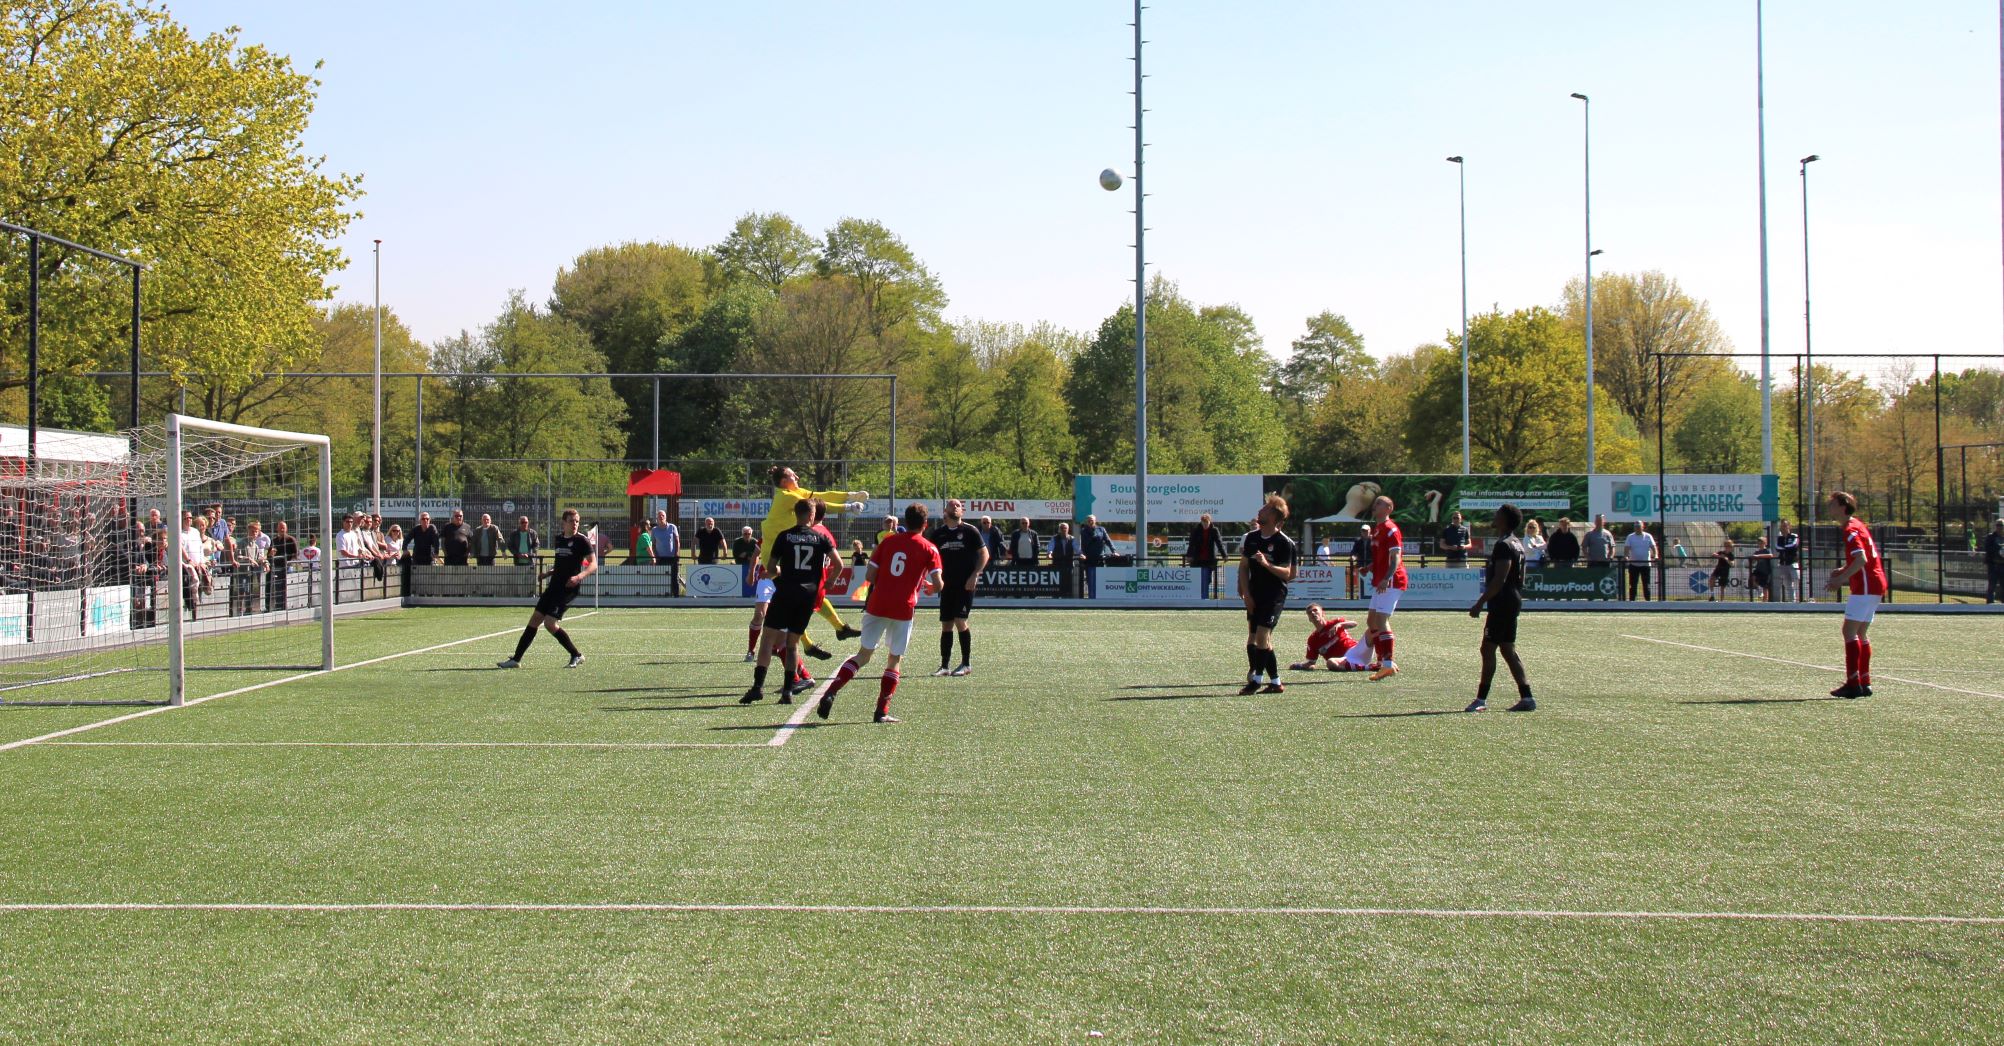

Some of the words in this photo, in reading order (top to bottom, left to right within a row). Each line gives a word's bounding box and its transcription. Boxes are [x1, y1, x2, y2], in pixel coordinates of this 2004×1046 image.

[1479, 489, 1514, 497] informatie
[1653, 494, 1744, 512] DOPPENBERG
[794, 545, 814, 570] 12
[890, 552, 907, 576] 6
[1151, 570, 1191, 580] LANGE
[1534, 581, 1594, 593] HappyFood
